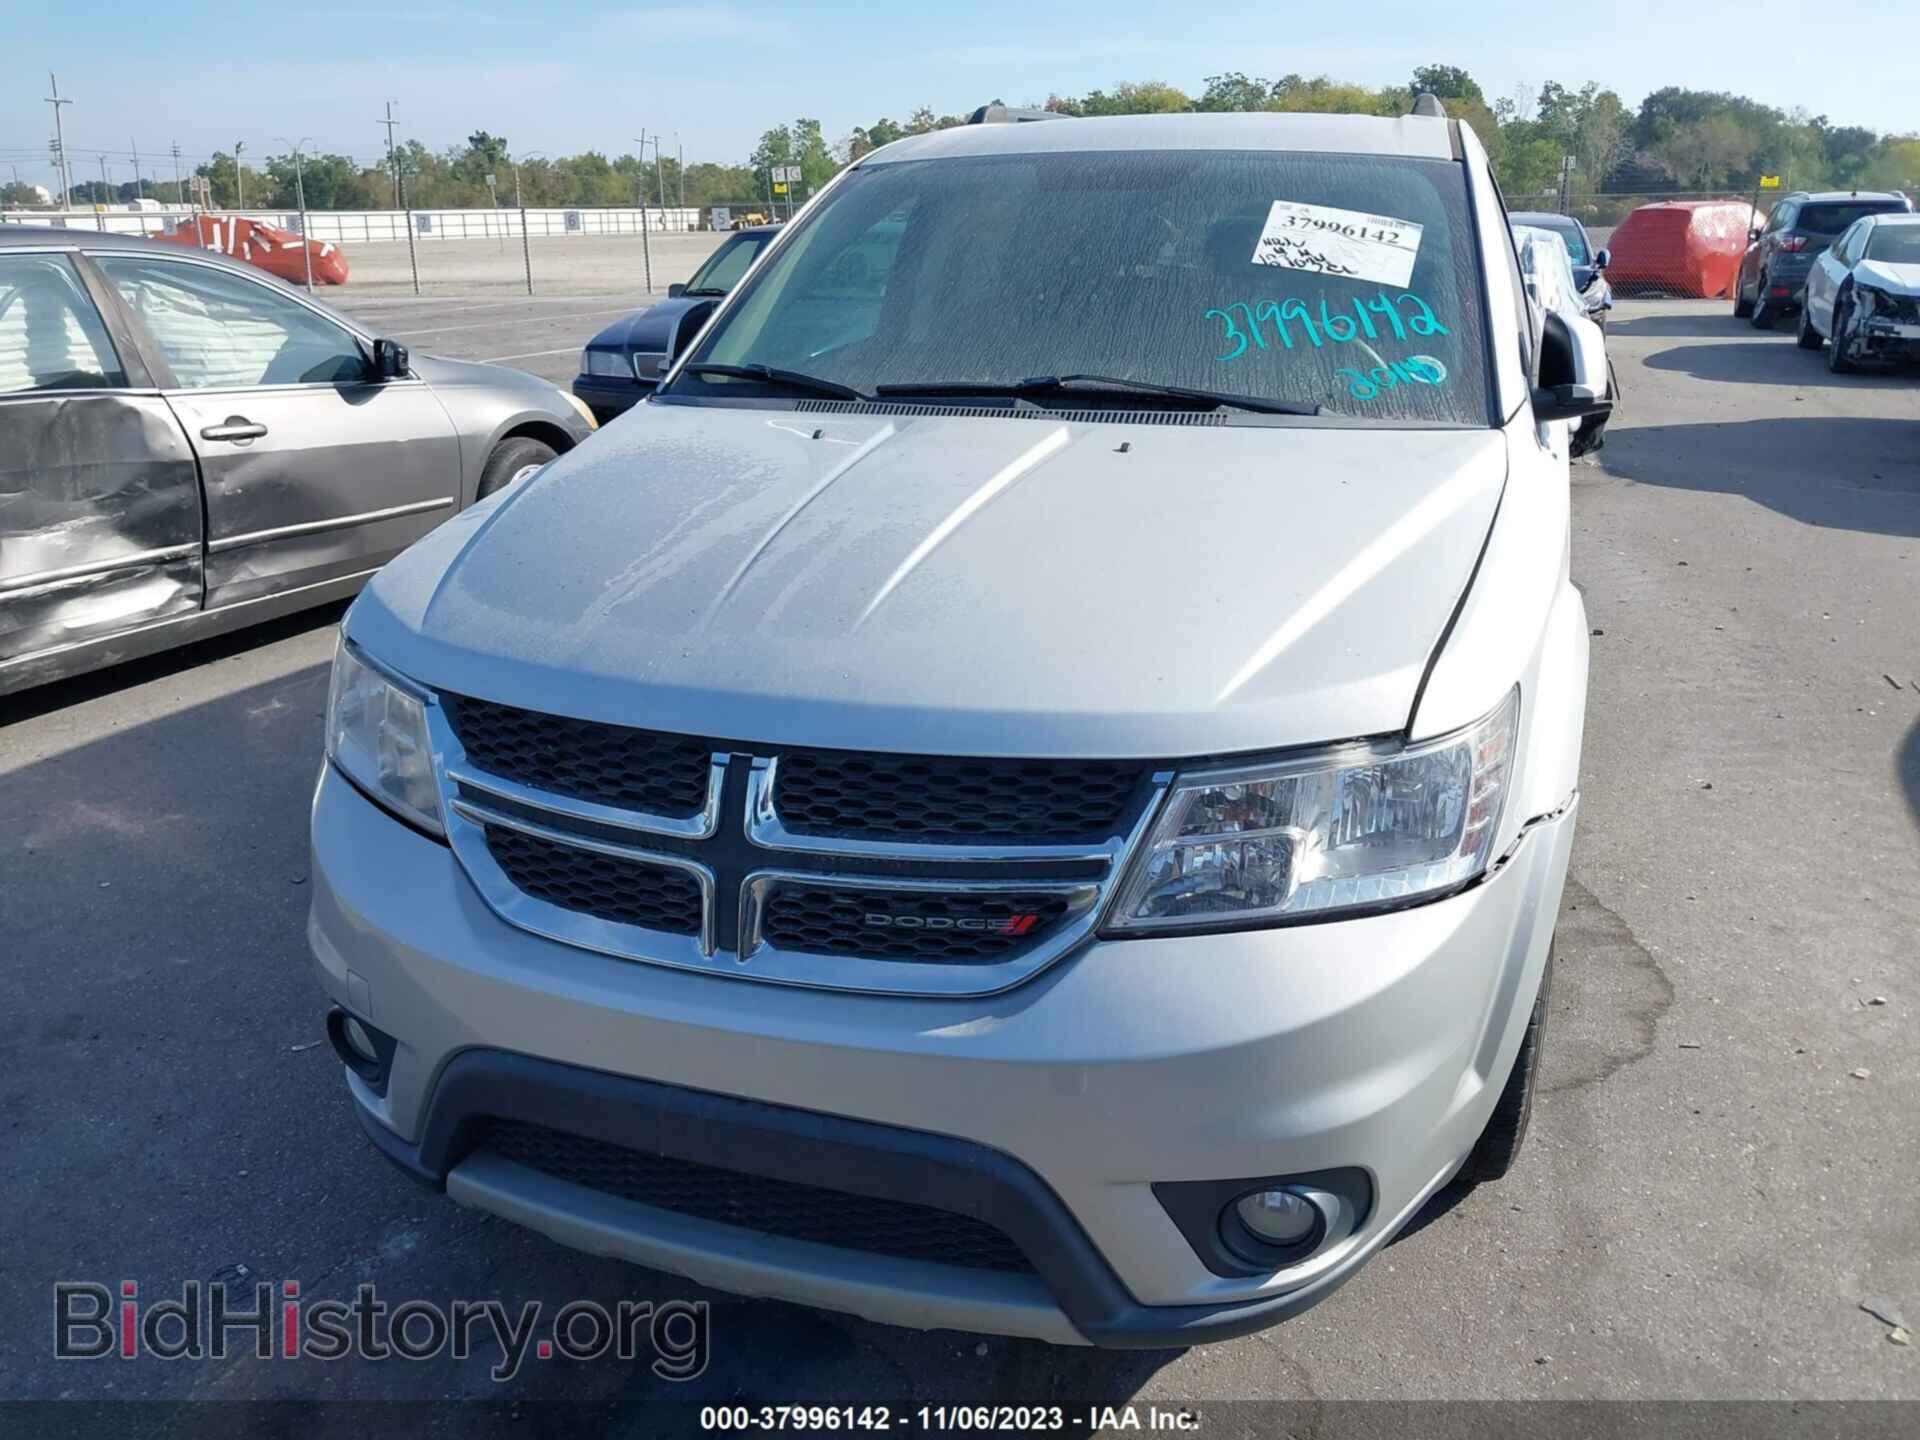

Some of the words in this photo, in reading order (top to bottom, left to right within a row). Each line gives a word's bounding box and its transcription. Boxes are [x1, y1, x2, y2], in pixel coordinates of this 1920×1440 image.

[1281, 215, 1400, 245] 37996142
[1204, 290, 1451, 361] 37996142
[864, 913, 1013, 930] DODGE
